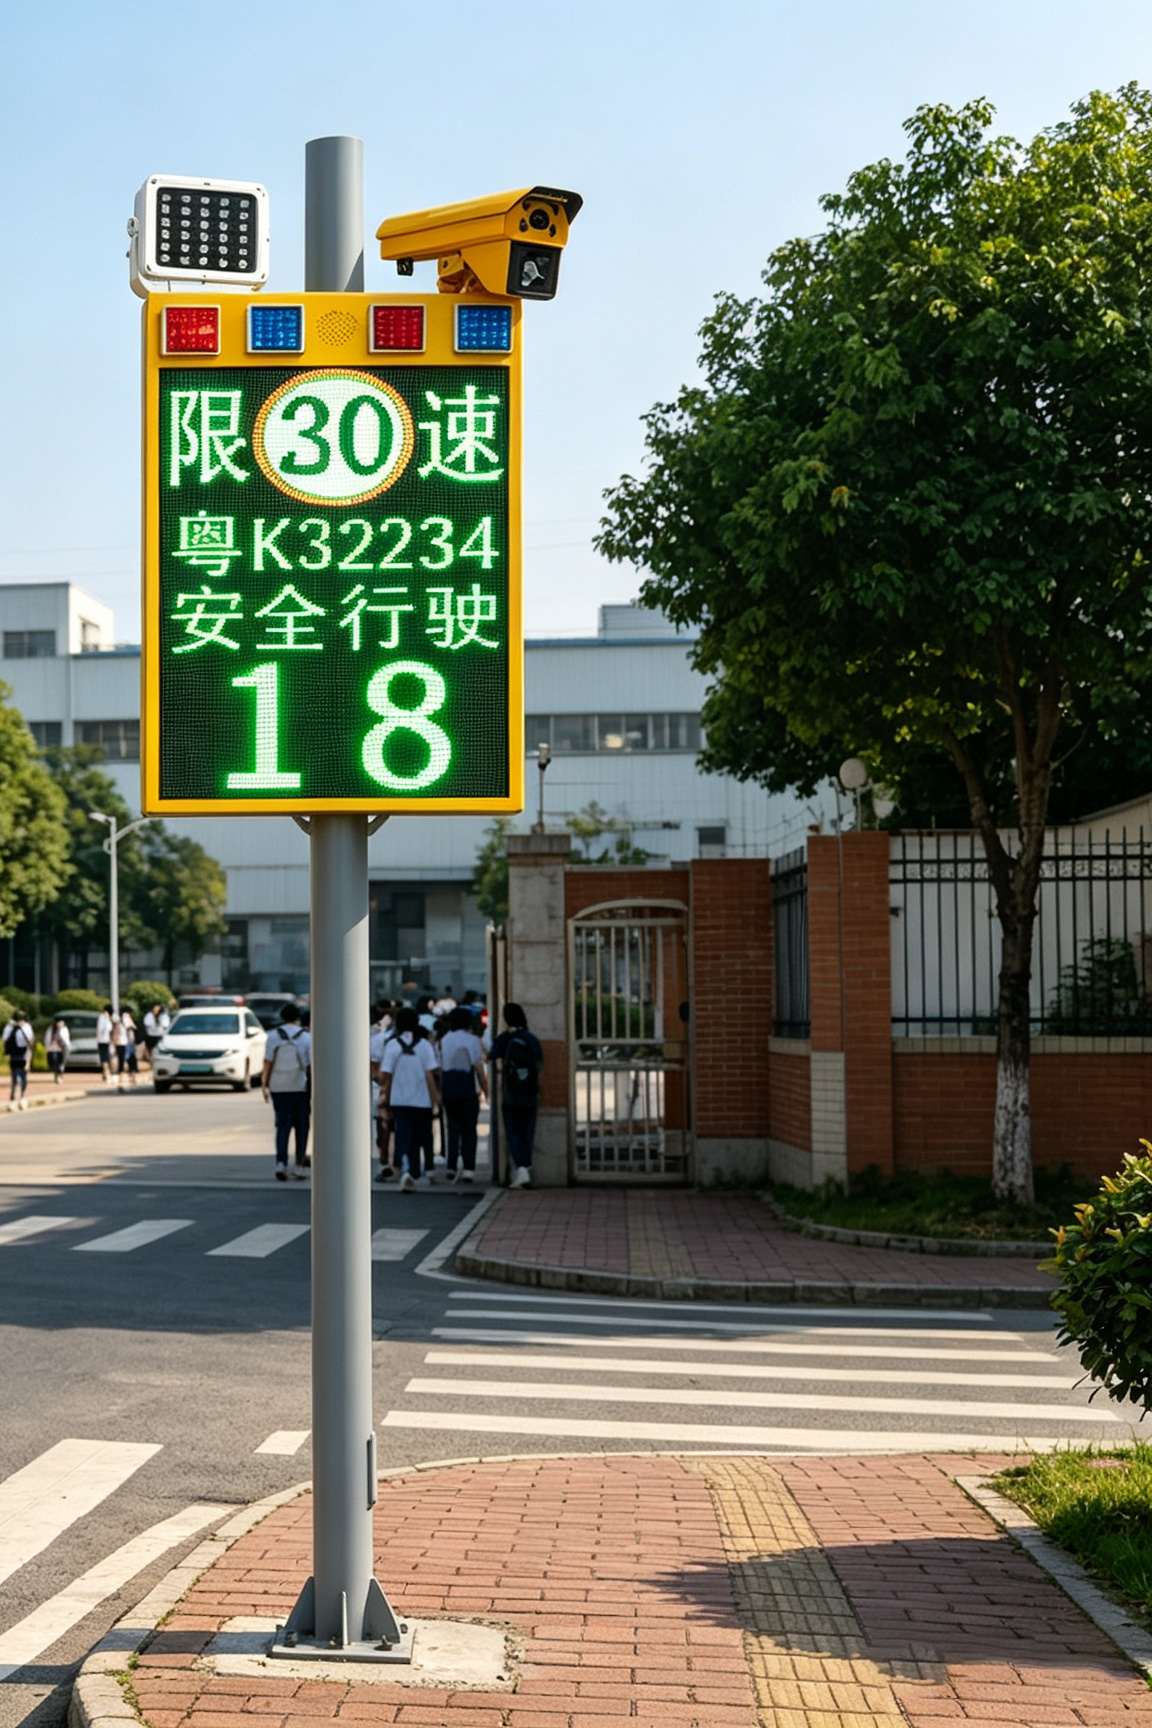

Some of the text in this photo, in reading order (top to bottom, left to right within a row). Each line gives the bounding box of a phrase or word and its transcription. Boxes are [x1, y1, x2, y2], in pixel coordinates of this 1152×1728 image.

[169, 385, 505, 487] 限 30 速
[171, 510, 499, 577] 粤K32234
[171, 584, 500, 654] 安全行驶
